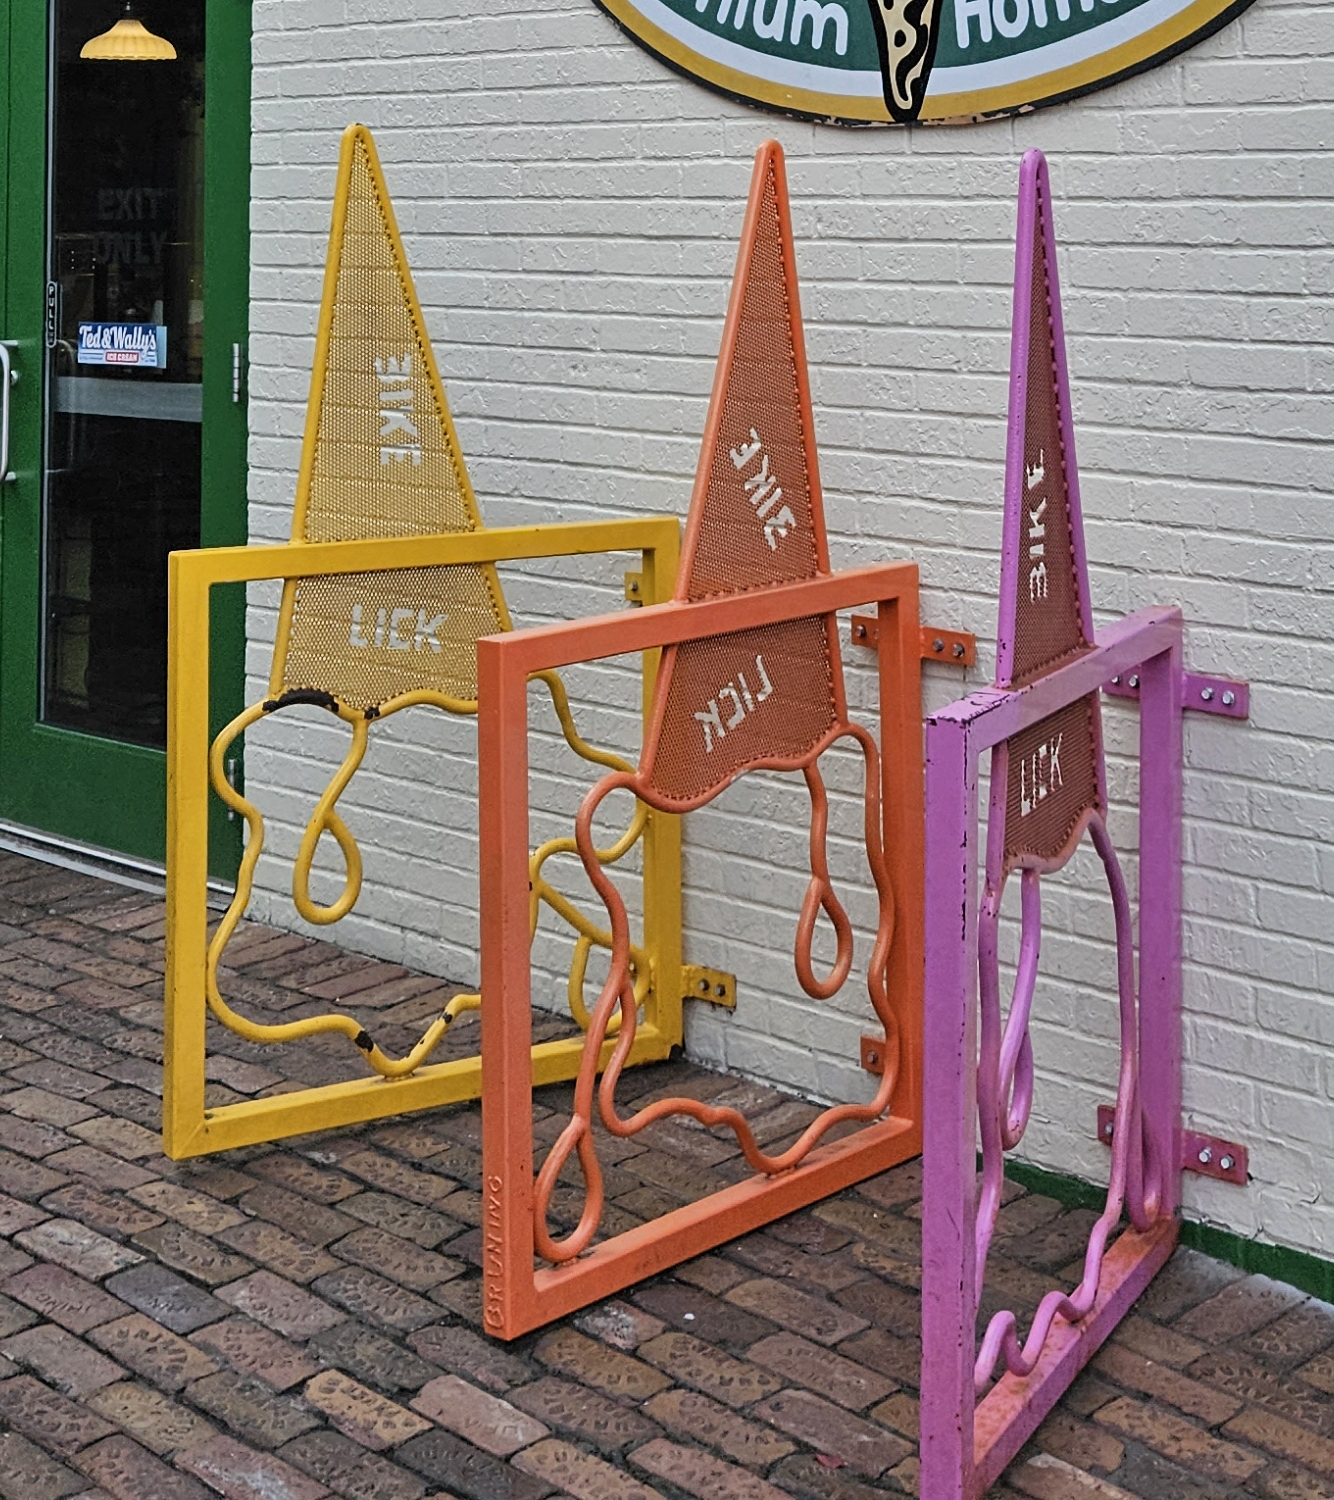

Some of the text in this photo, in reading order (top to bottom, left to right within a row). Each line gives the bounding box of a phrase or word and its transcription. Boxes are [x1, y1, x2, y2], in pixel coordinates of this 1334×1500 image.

[97, 187, 165, 220] EXIT
[92, 231, 167, 265] ONLY
[79, 325, 156, 360] Ted & Wally's
[374, 352, 421, 466] BIKE
[349, 602, 448, 653] LICK
[1021, 732, 1064, 817] LICK
